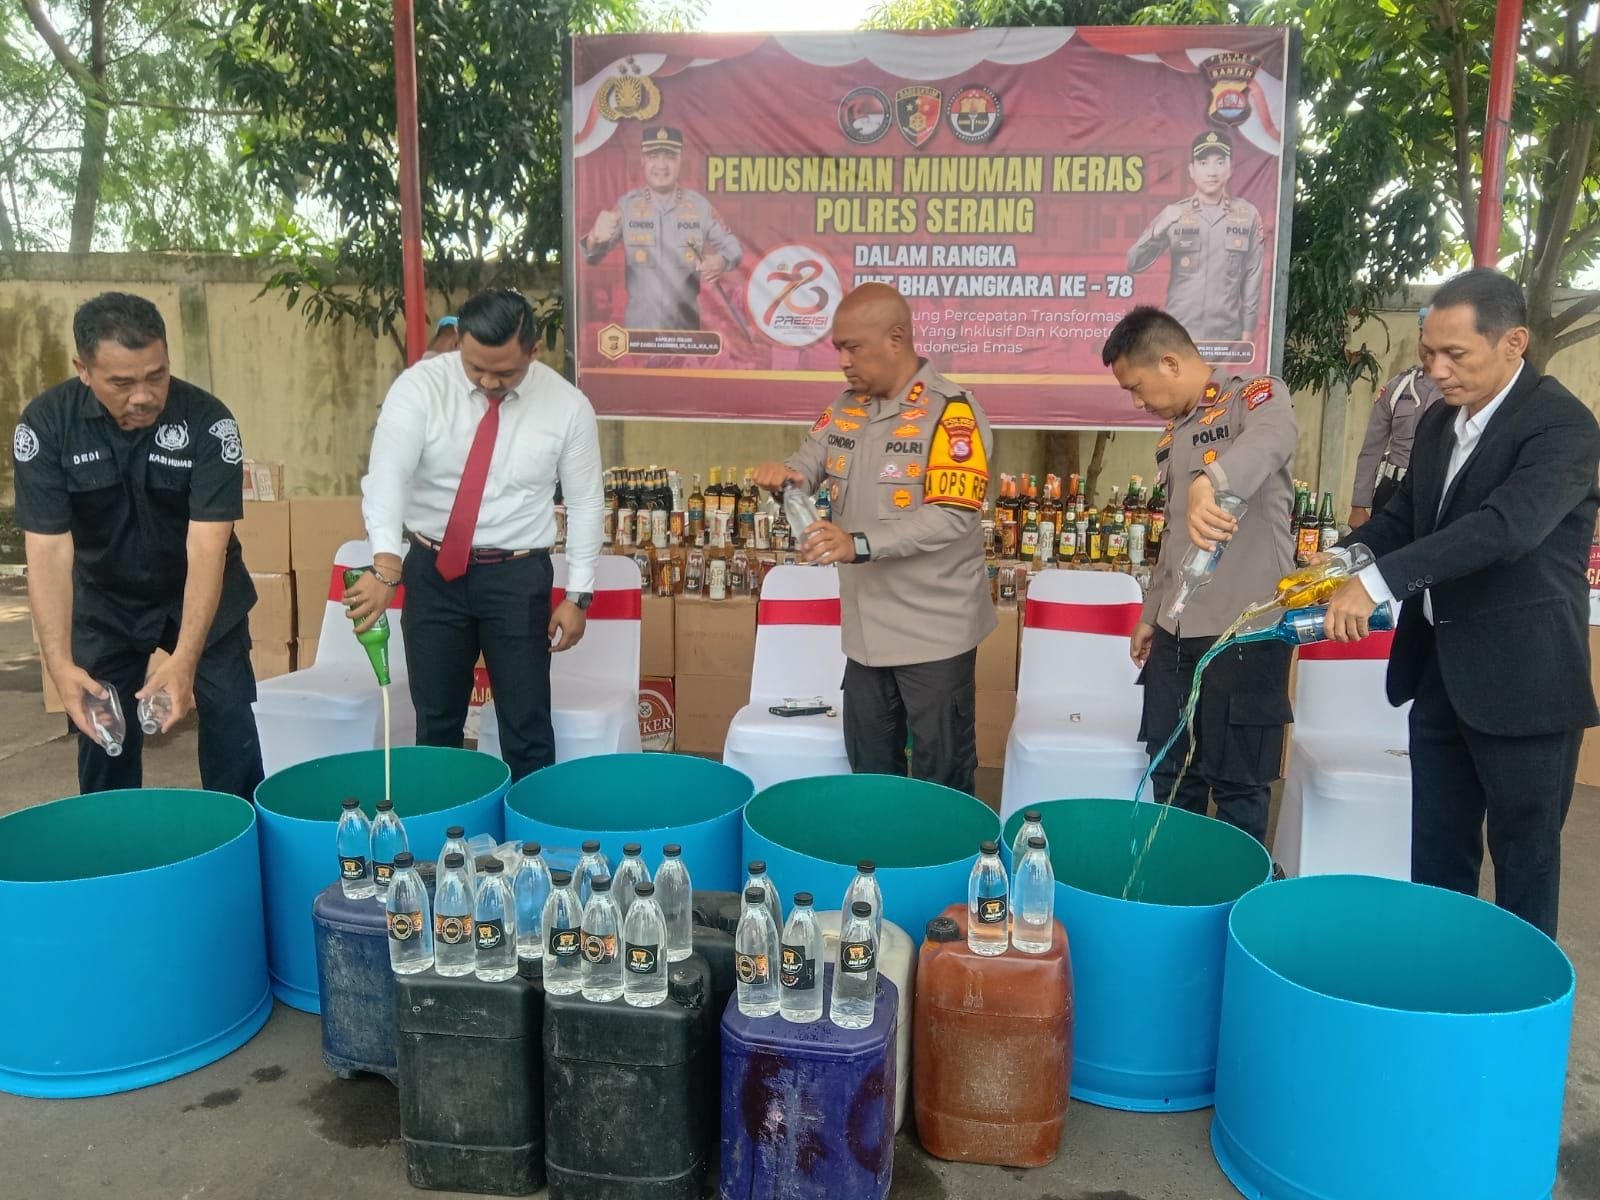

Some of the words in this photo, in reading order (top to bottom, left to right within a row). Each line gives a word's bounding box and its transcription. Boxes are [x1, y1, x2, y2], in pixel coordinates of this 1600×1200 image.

[707, 156, 894, 193] PEMUSNAHAN
[903, 156, 1043, 193] MINUMAN
[1052, 156, 1143, 193] KERAS
[816, 198, 918, 234] POLRES
[926, 198, 1035, 234] SERANG
[855, 244, 928, 268] DALAM
[931, 244, 1017, 268] RANGKA
[898, 274, 1055, 297] BHAYANGKARA
[1059, 274, 1087, 297] KE
[1106, 274, 1133, 298] 78
[773, 315, 829, 326] PRESISI
[911, 311, 940, 324] ung
[944, 309, 1027, 326] Percepatan
[1031, 309, 1126, 322] Transformasi
[919, 326, 956, 340] Yang
[960, 325, 1013, 338] Inklusif
[1015, 326, 1045, 338] Dan
[913, 341, 978, 354] ndonesia
[983, 342, 1024, 354] Emas
[827, 433, 856, 451] CONDRO
[1192, 424, 1230, 447] POLRI
[884, 441, 923, 455] POLRI
[938, 471, 967, 497] OPS
[470, 687, 492, 704] AJA
[643, 716, 673, 734] KER
